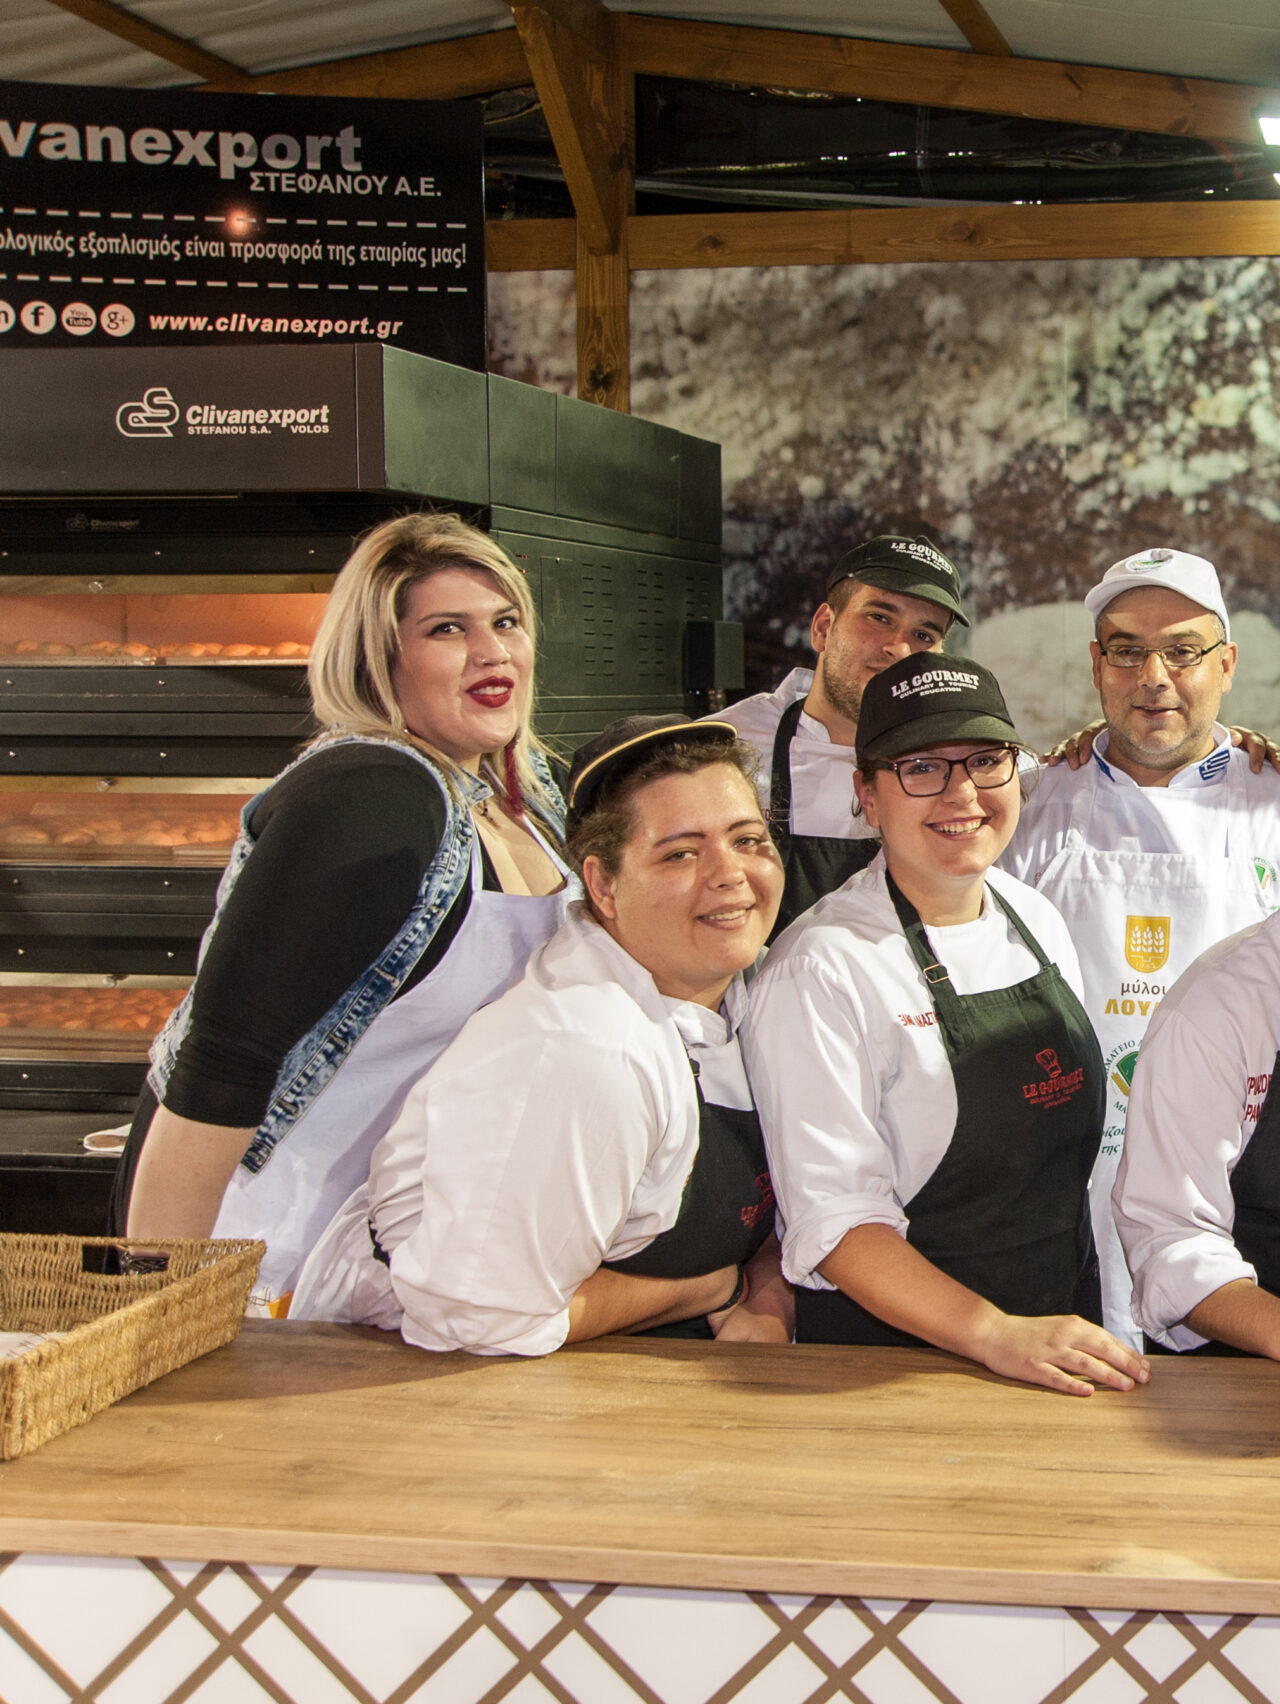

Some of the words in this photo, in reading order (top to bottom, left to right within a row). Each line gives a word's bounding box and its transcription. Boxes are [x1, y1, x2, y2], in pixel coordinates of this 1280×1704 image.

[250, 172, 388, 196] ΣΤΕΦΑΝΟΥ
[394, 176, 442, 197] Α.Ε.
[79, 232, 181, 262] εξοπλισμός
[185, 235, 225, 257] είναι
[229, 239, 323, 265] προσφορά
[327, 245, 356, 266] της
[360, 241, 427, 268] εταιρίας
[431, 243, 467, 268] μας!
[149, 313, 403, 339] www.clivanexport.gr
[186, 404, 330, 428] Clivanexport
[188, 425, 247, 435] STEFANOU
[249, 425, 272, 434] S.A.
[290, 424, 330, 434] VOLOS
[891, 680, 910, 697] LE
[911, 670, 979, 687] GOURMET
[1120, 979, 1167, 997] μύλοι
[1101, 1144, 1120, 1156] της
